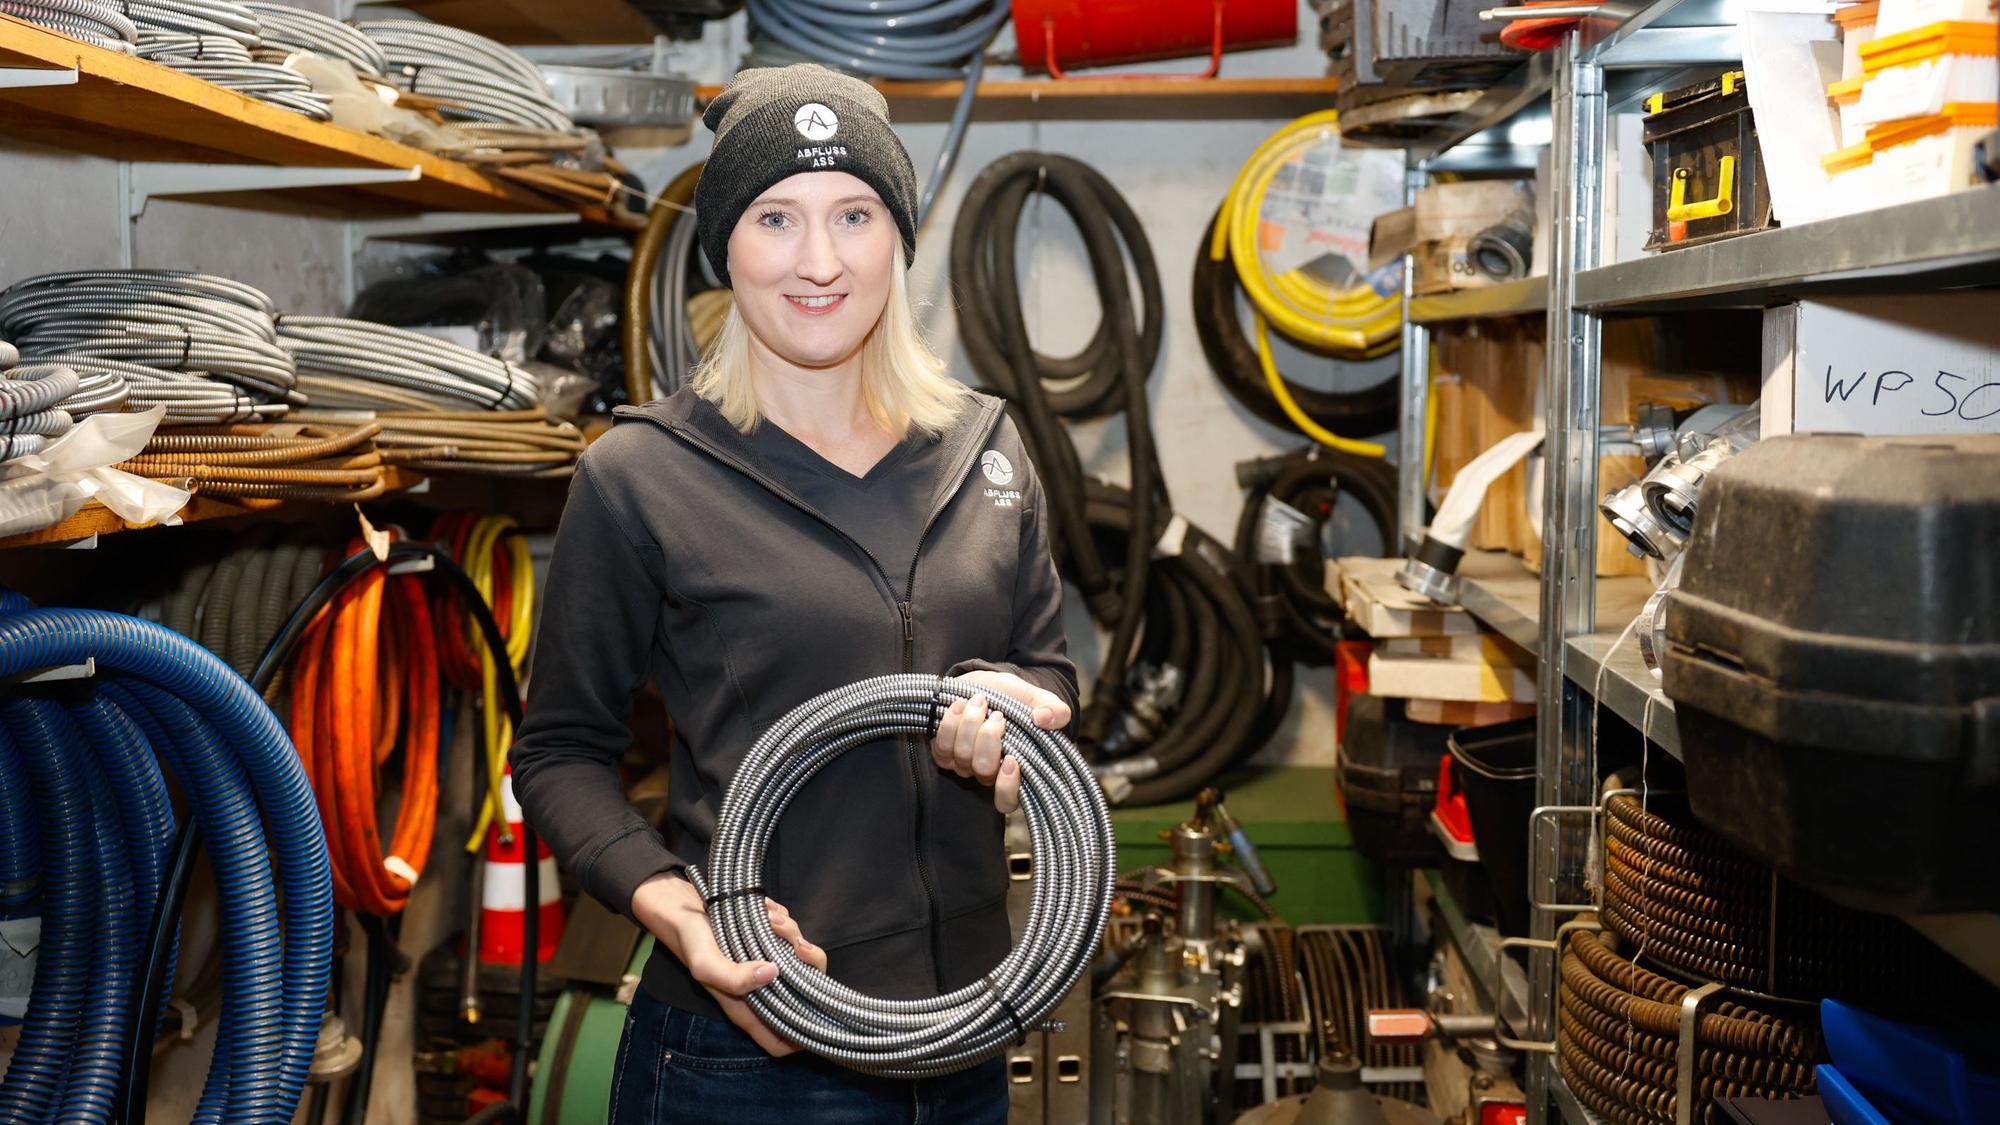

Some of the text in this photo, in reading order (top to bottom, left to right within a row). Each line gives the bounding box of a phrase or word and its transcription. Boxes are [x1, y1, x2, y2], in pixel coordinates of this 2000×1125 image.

[797, 146, 847, 158] ABFLUSS
[812, 156, 835, 167] ASS
[1824, 365, 2000, 421] WP 50
[983, 488, 1021, 499] ABFLUSS
[994, 498, 1012, 506] ASS
